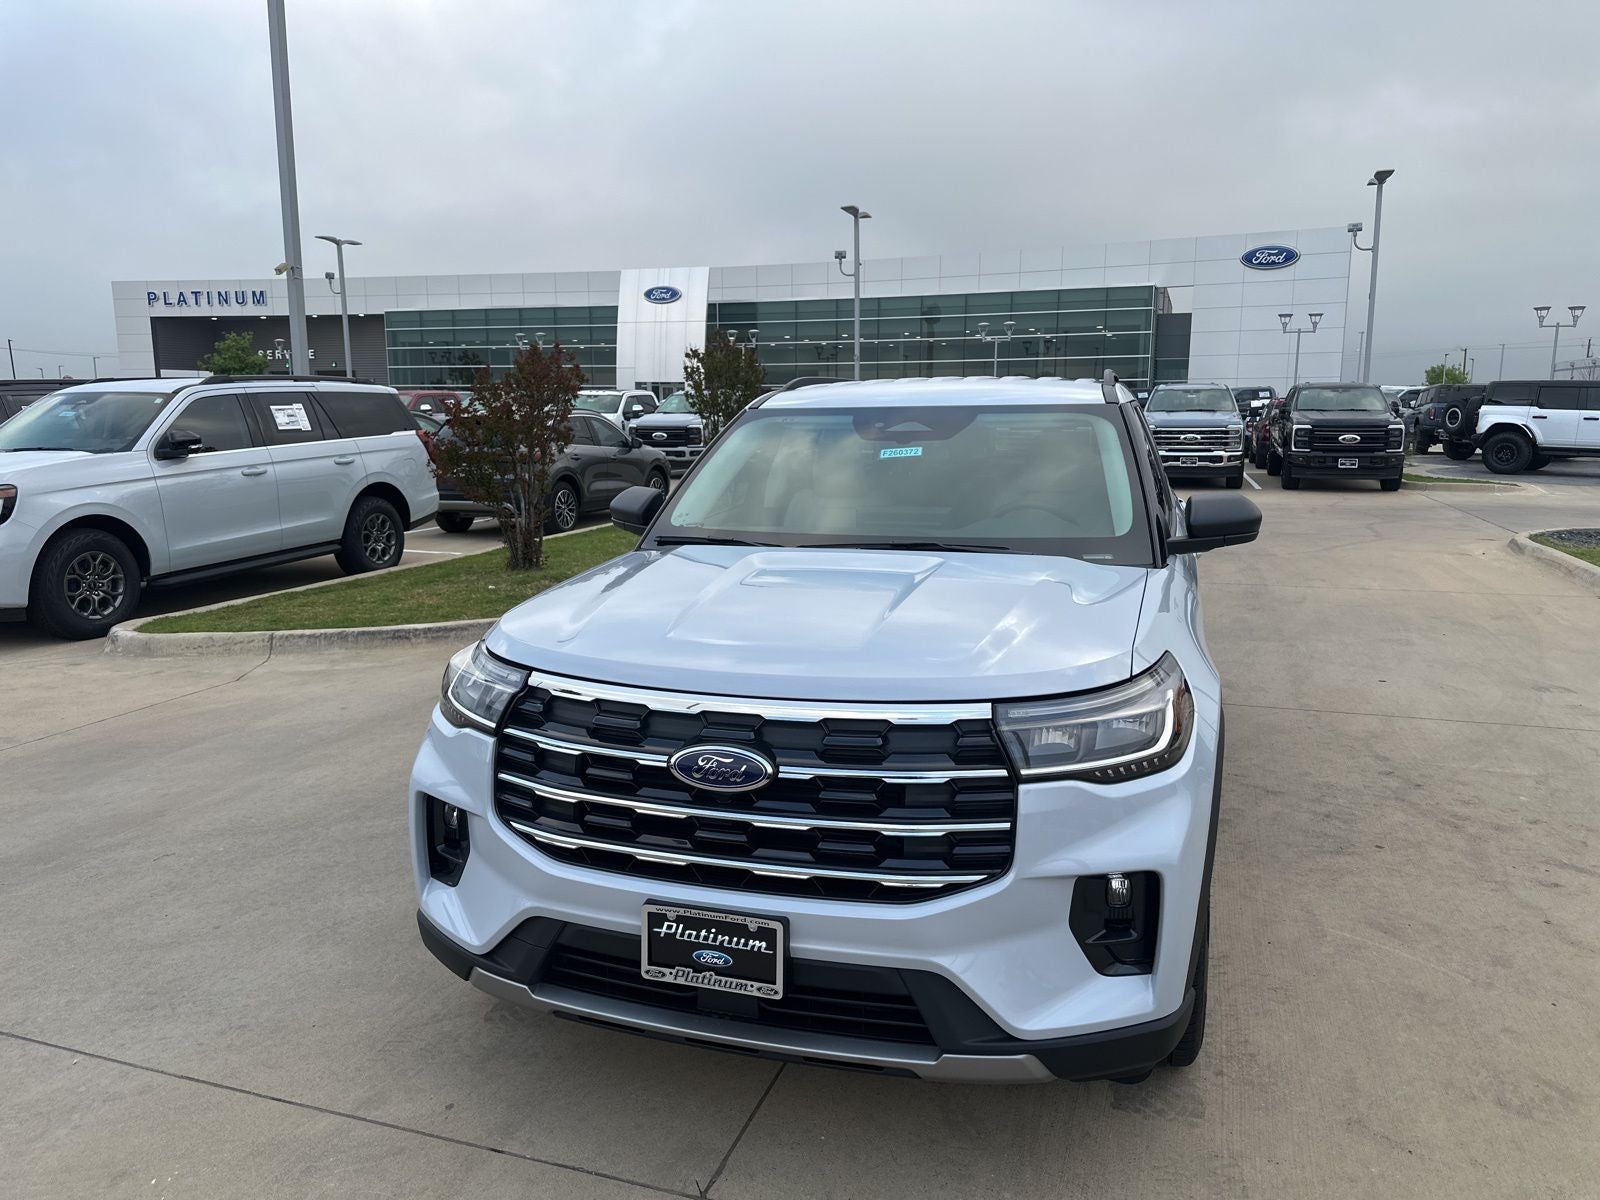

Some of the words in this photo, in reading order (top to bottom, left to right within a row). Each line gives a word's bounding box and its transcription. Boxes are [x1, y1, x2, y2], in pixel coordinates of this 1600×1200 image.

[1253, 249, 1287, 264] Ford
[146, 290, 267, 307] PLATINUM
[650, 288, 672, 299] Ford
[257, 349, 315, 360] SERVE
[691, 754, 748, 782] Ford
[655, 906, 771, 927] www.PlatinumFord.com
[652, 921, 774, 954] Platinum
[700, 952, 725, 965] Ford
[672, 967, 755, 993] Platinum
